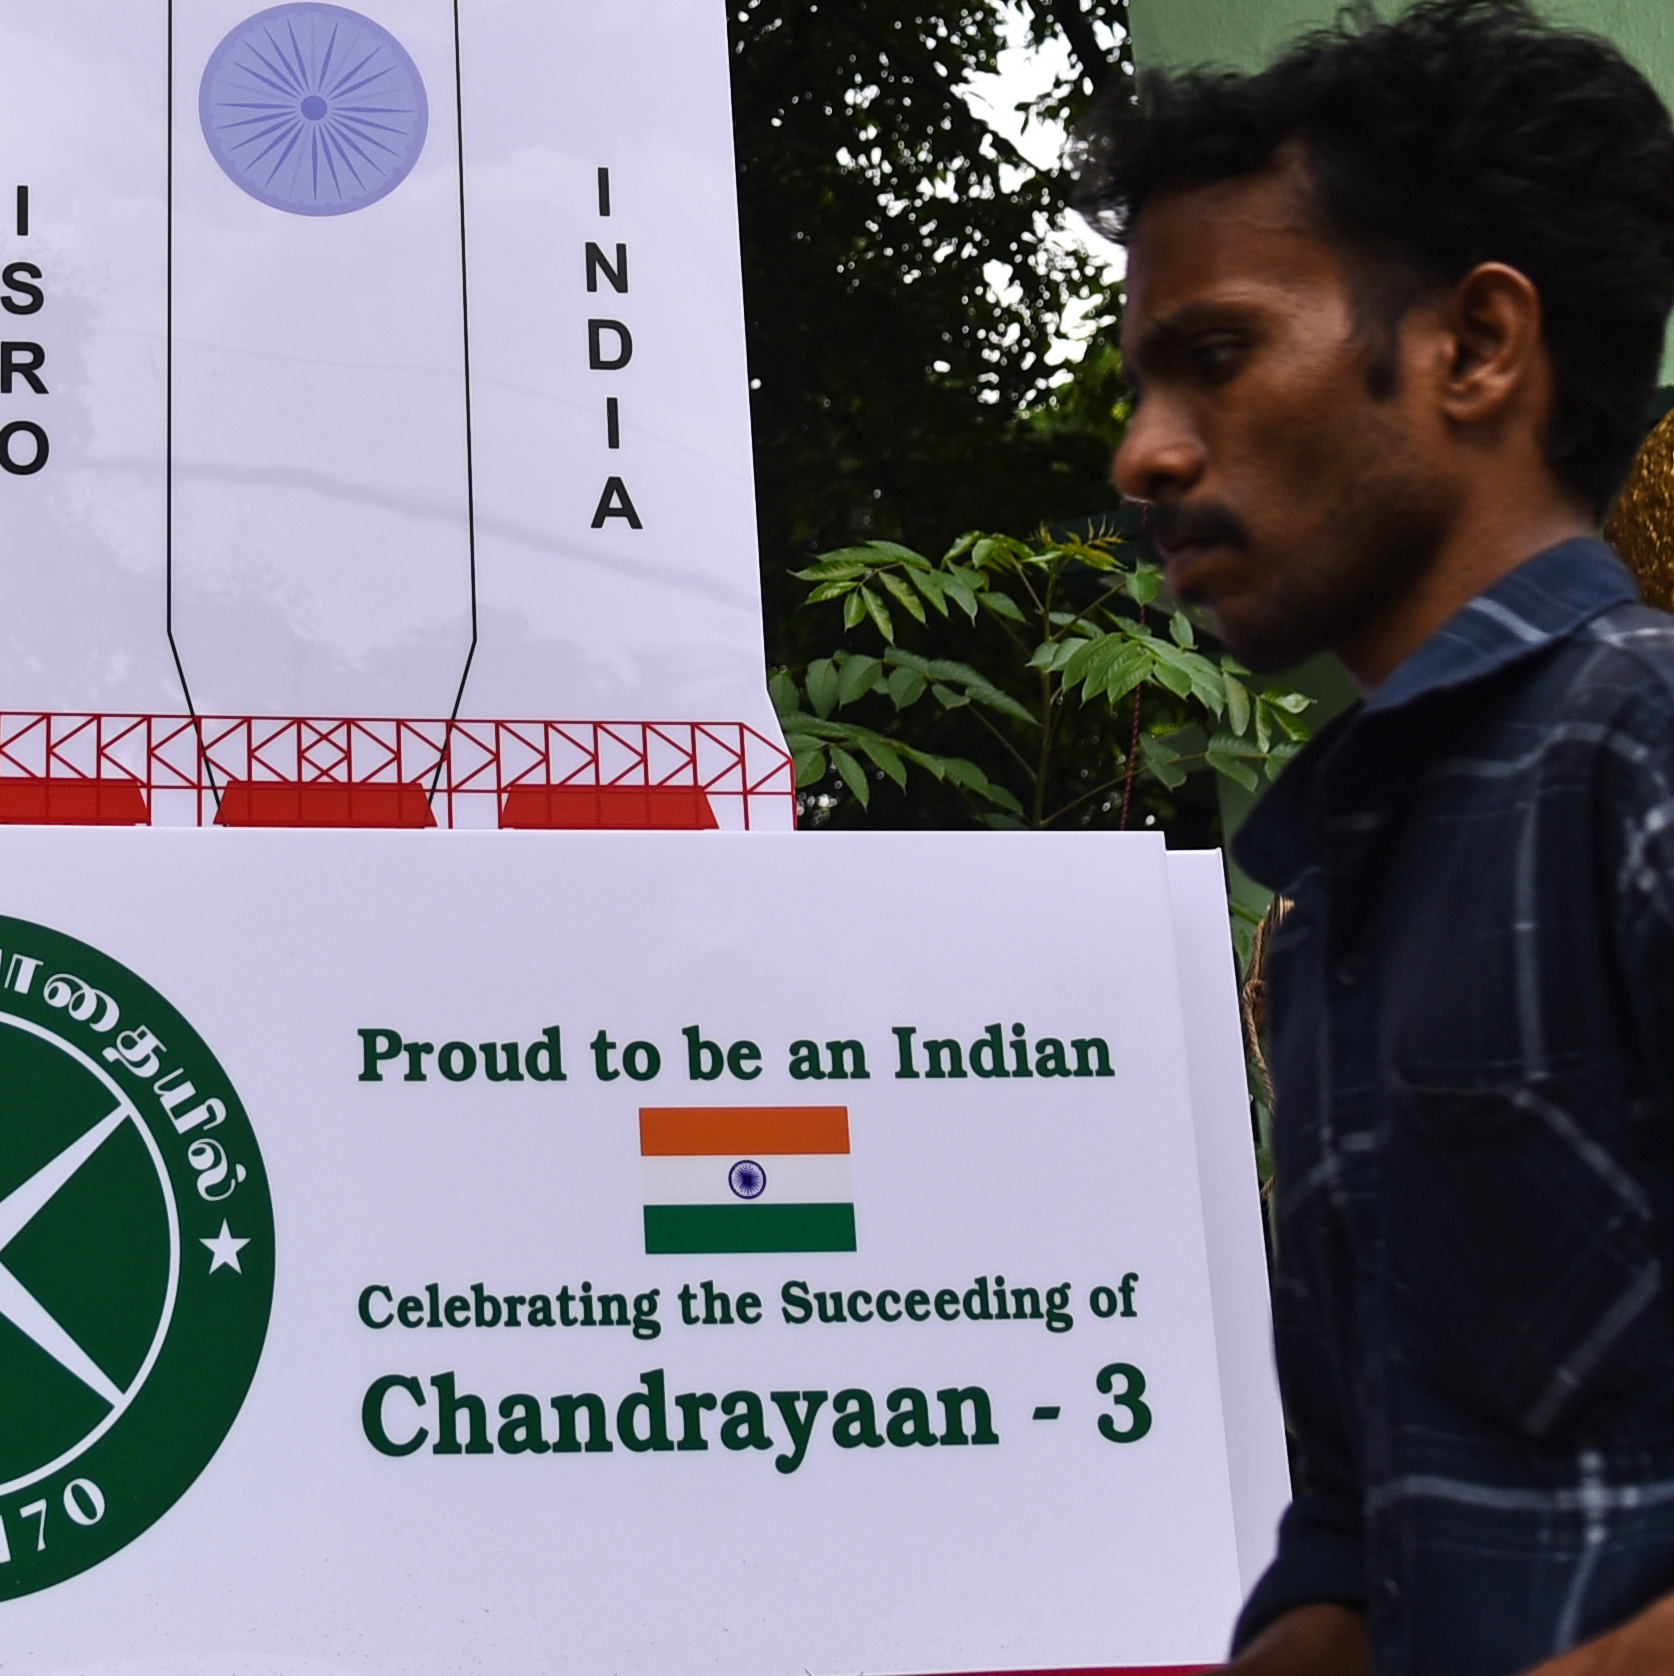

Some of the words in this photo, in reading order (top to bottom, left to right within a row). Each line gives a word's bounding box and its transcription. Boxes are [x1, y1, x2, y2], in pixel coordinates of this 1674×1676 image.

[585, 167, 643, 530] INDIA
[358, 1026, 567, 1082] Proud
[591, 1032, 661, 1081] to
[683, 1024, 763, 1080] be
[788, 1036, 871, 1080] an
[894, 1023, 1115, 1079] Indian
[358, 1281, 661, 1340] Celebrating
[679, 1280, 762, 1324] the
[782, 1275, 1073, 1333] Succeeding
[1089, 1272, 1138, 1318] of
[361, 1367, 999, 1474] Chandrayaan
[1096, 1362, 1152, 1443] 3
